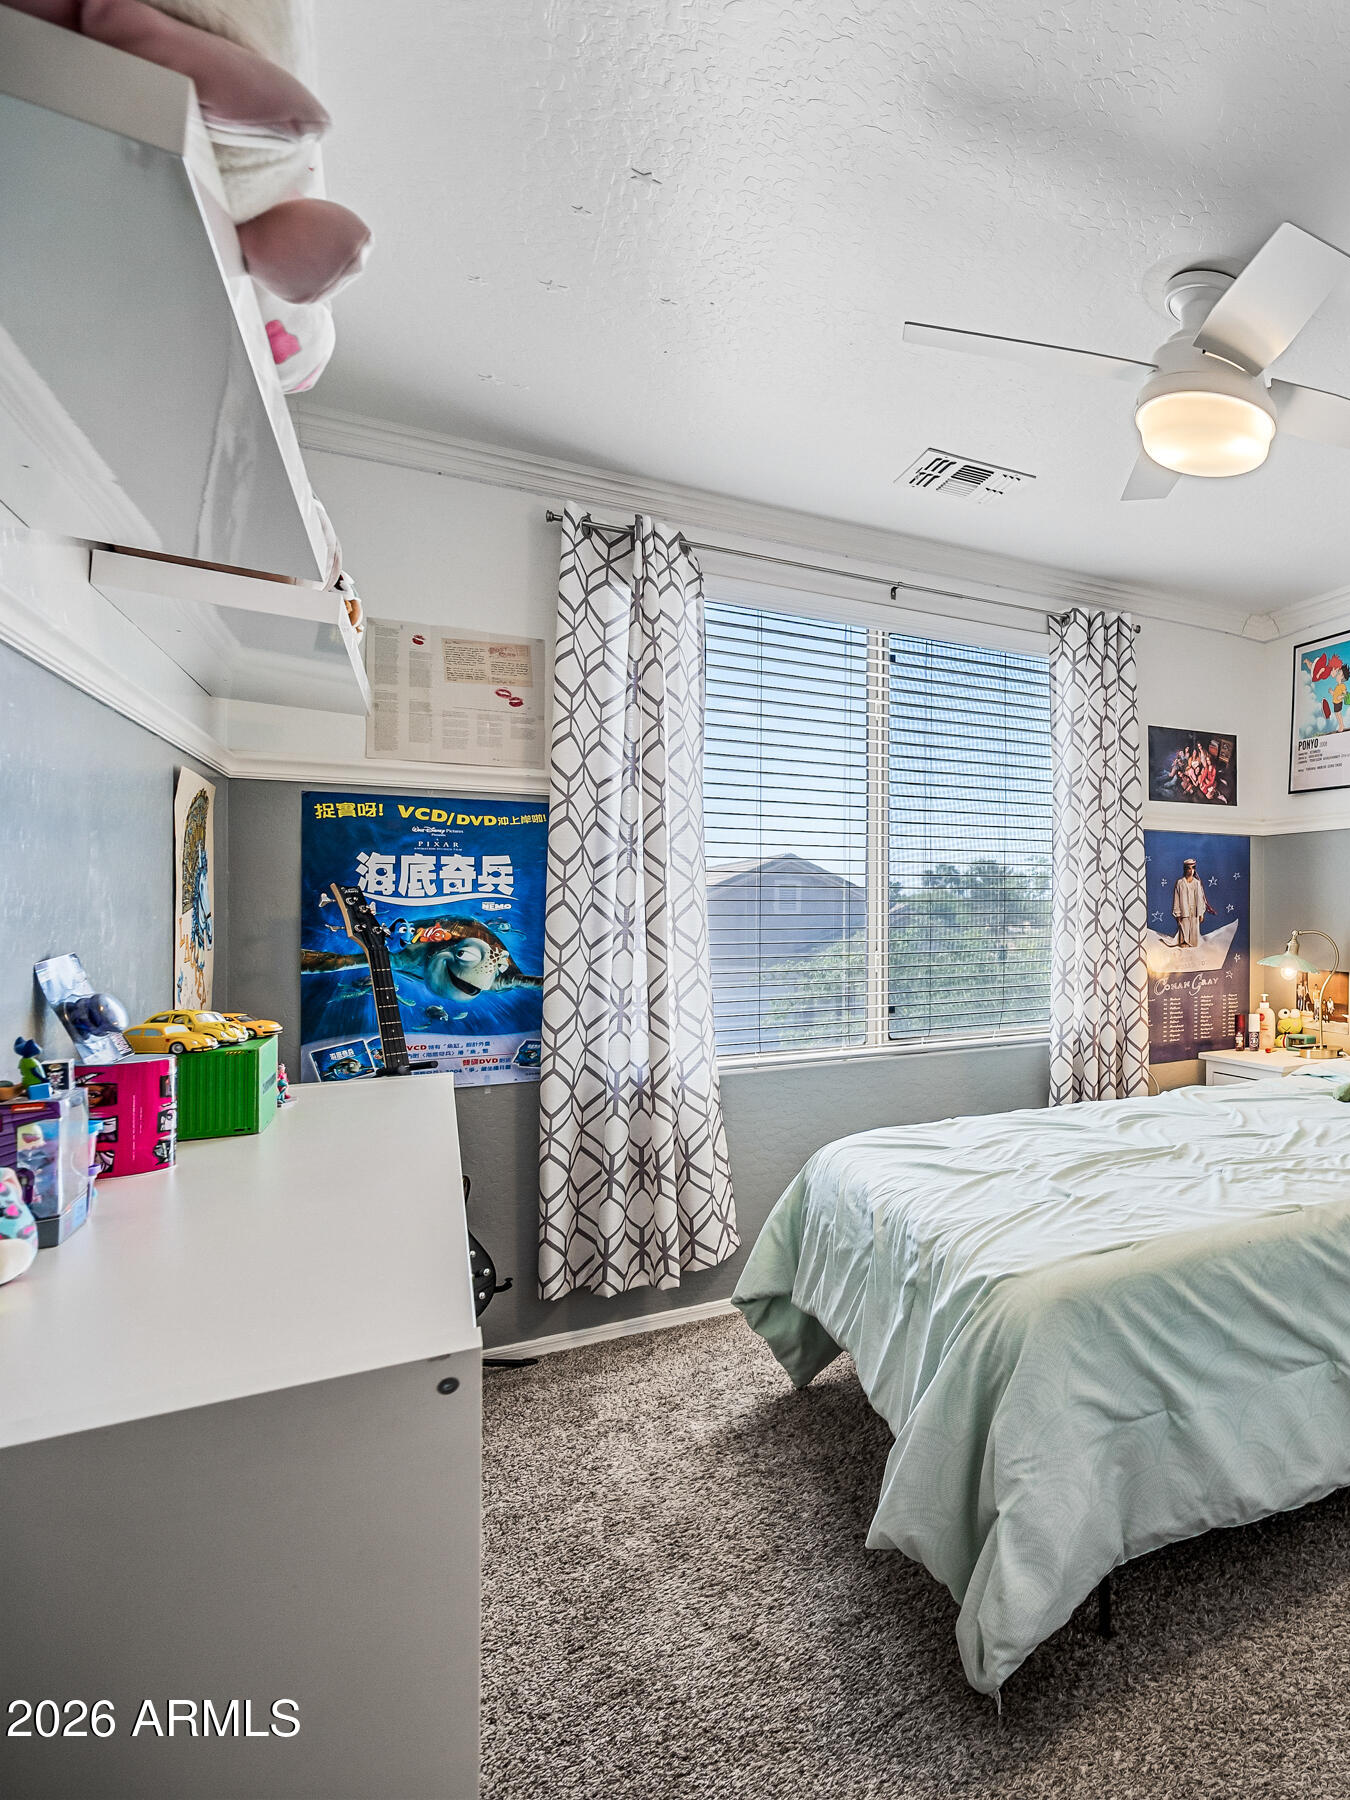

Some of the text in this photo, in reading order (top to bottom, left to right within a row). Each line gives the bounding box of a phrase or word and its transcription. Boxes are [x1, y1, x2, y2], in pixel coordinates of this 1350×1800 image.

[1298, 738, 1318, 751] PONYO
[398, 804, 496, 826] VCD/DVD
[356, 852, 514, 896] 海底奇兵
